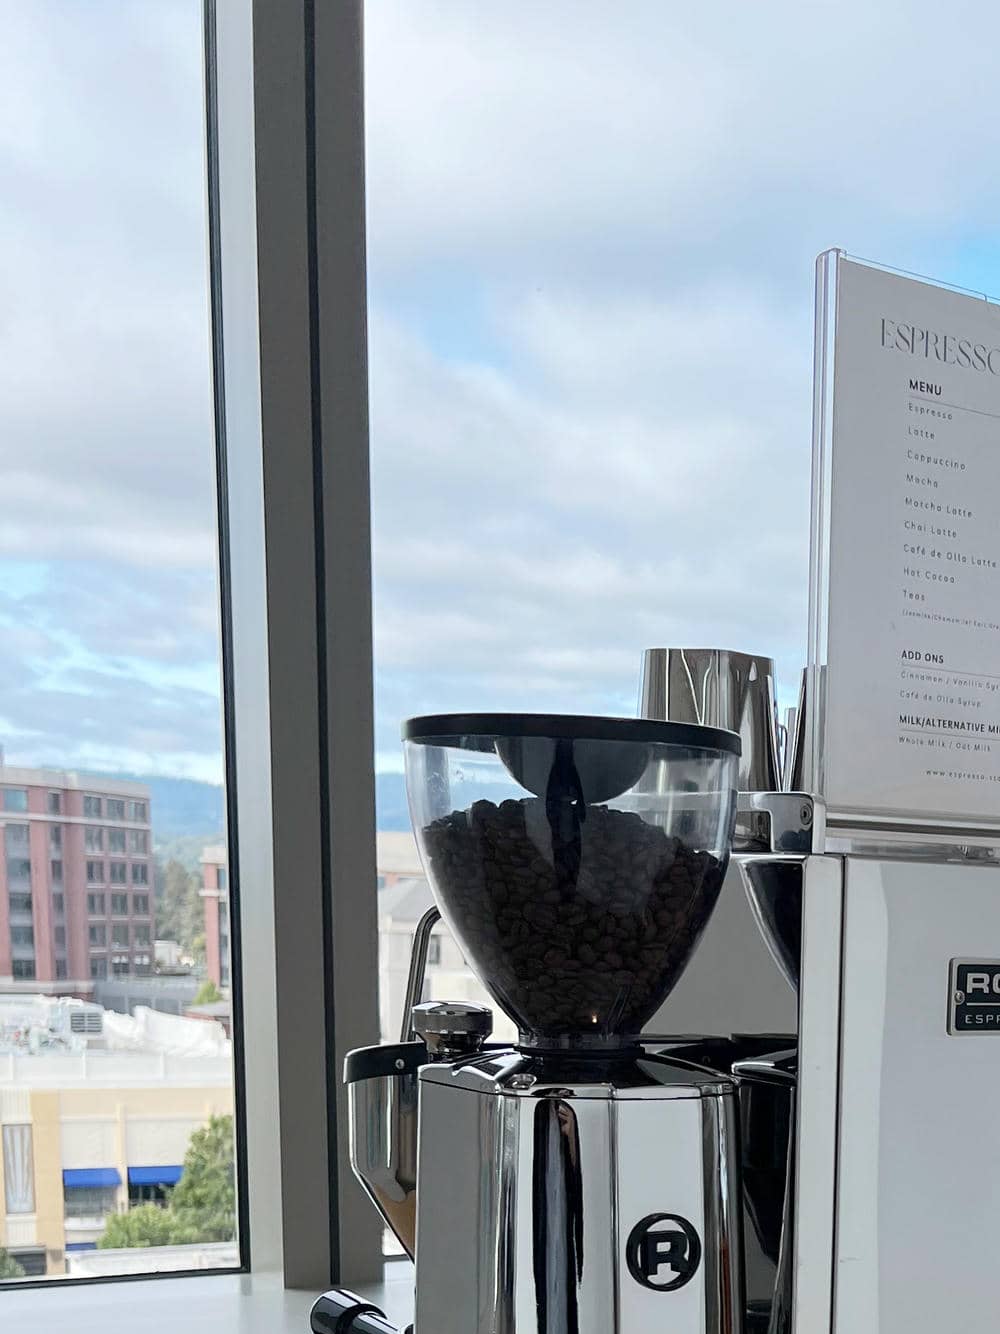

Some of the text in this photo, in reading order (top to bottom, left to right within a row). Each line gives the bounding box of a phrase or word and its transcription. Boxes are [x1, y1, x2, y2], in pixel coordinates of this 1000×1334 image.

[909, 379, 942, 396] MENU
[908, 402, 953, 421] Espresso
[908, 426, 935, 440] Latte
[907, 449, 966, 471] Cappuccino
[906, 473, 938, 488] Mocha
[905, 497, 973, 518] Matcha Latte
[904, 520, 957, 538] Chai Latte
[903, 543, 997, 568] Café de Olla Latte
[903, 566, 955, 584] Hot Cocoa
[903, 589, 926, 601] Teas
[901, 649, 945, 664] ADD ONS
[901, 671, 943, 683] Cinnamon
[953, 678, 984, 689] Vanilla
[957, 697, 982, 709] Syrup
[899, 715, 985, 733] MILK/ALTERNATIVE
[899, 736, 924, 746] Whole
[927, 739, 946, 749] Milk
[973, 744, 992, 753] Milk
